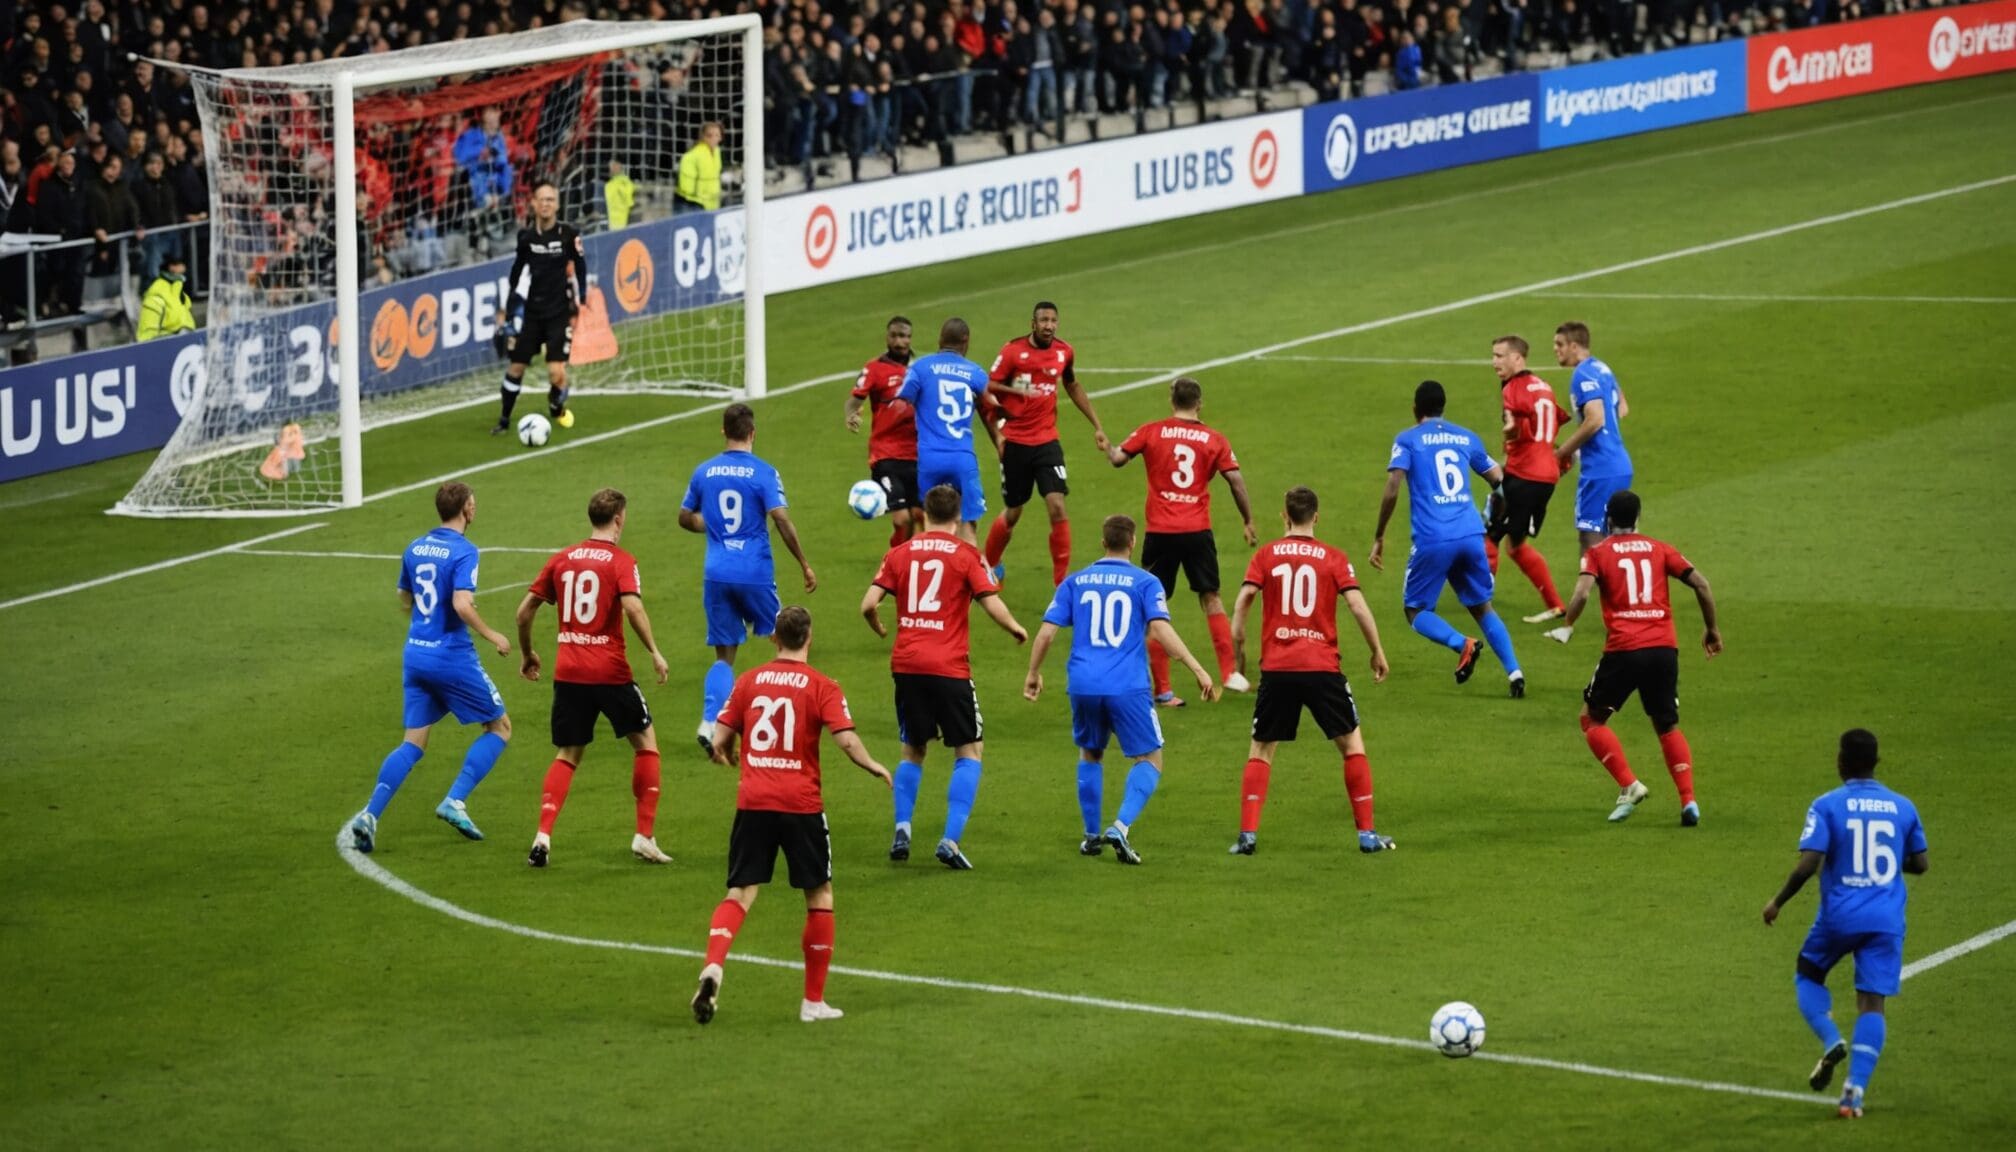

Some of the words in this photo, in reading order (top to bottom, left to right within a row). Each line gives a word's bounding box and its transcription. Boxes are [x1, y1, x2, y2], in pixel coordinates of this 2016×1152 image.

[1171, 443, 1196, 489] 3
[1435, 448, 1464, 497] 6
[718, 489, 743, 535] 9
[560, 569, 600, 625] 18
[907, 558, 945, 613] 12
[1271, 562, 1317, 618] 10
[1845, 818, 1898, 886] 16
